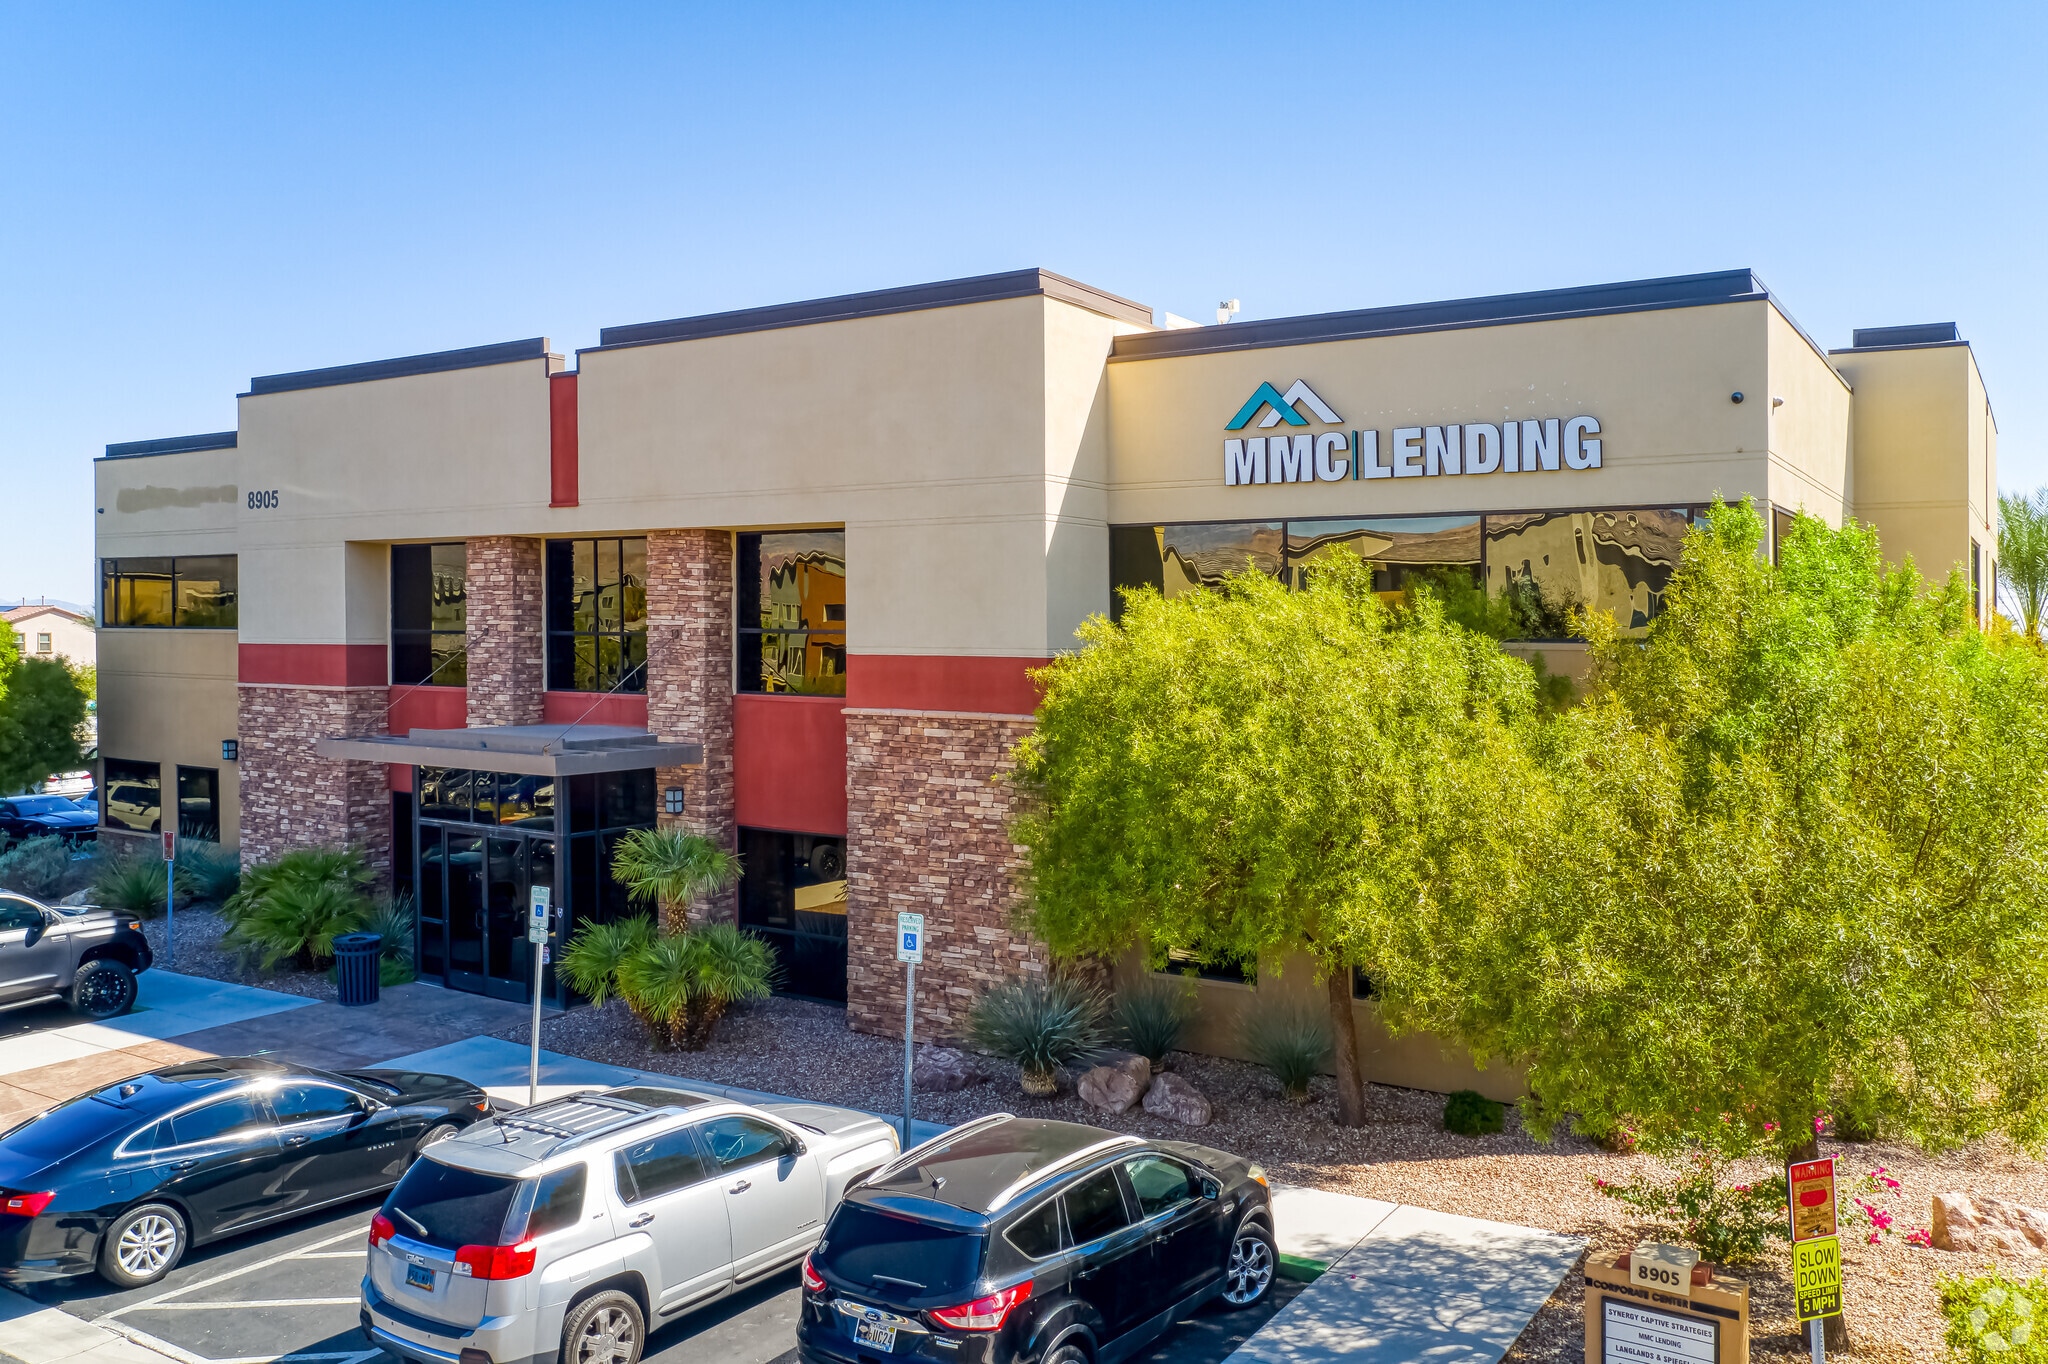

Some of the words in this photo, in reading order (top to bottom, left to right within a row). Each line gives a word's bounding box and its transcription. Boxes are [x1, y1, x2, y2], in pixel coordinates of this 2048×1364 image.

[1224, 432, 1349, 486] MMC
[1362, 415, 1603, 480] LENDING
[247, 489, 279, 510] 8905
[1793, 1162, 1831, 1179] WARNING
[405, 1253, 425, 1265] GMC
[1800, 1247, 1834, 1268] SLOW
[1638, 1265, 1680, 1286] 8905
[1800, 1266, 1836, 1288] DOWN
[1593, 1280, 1650, 1300] CORPORATE
[1652, 1292, 1689, 1309] CENTER
[1800, 1288, 1821, 1300] SPEED
[1822, 1285, 1838, 1296] LIMIT
[1804, 1299, 1810, 1313] 5
[1812, 1294, 1836, 1311] MPH
[1608, 1308, 1639, 1321] SYNERGY
[1640, 1315, 1670, 1328] CAPTIVE
[1671, 1322, 1713, 1338] STRATEGIES
[1638, 1332, 1654, 1342] MMC
[1655, 1336, 1682, 1349] LENDING
[1615, 1344, 1655, 1360] LANGLANDS
